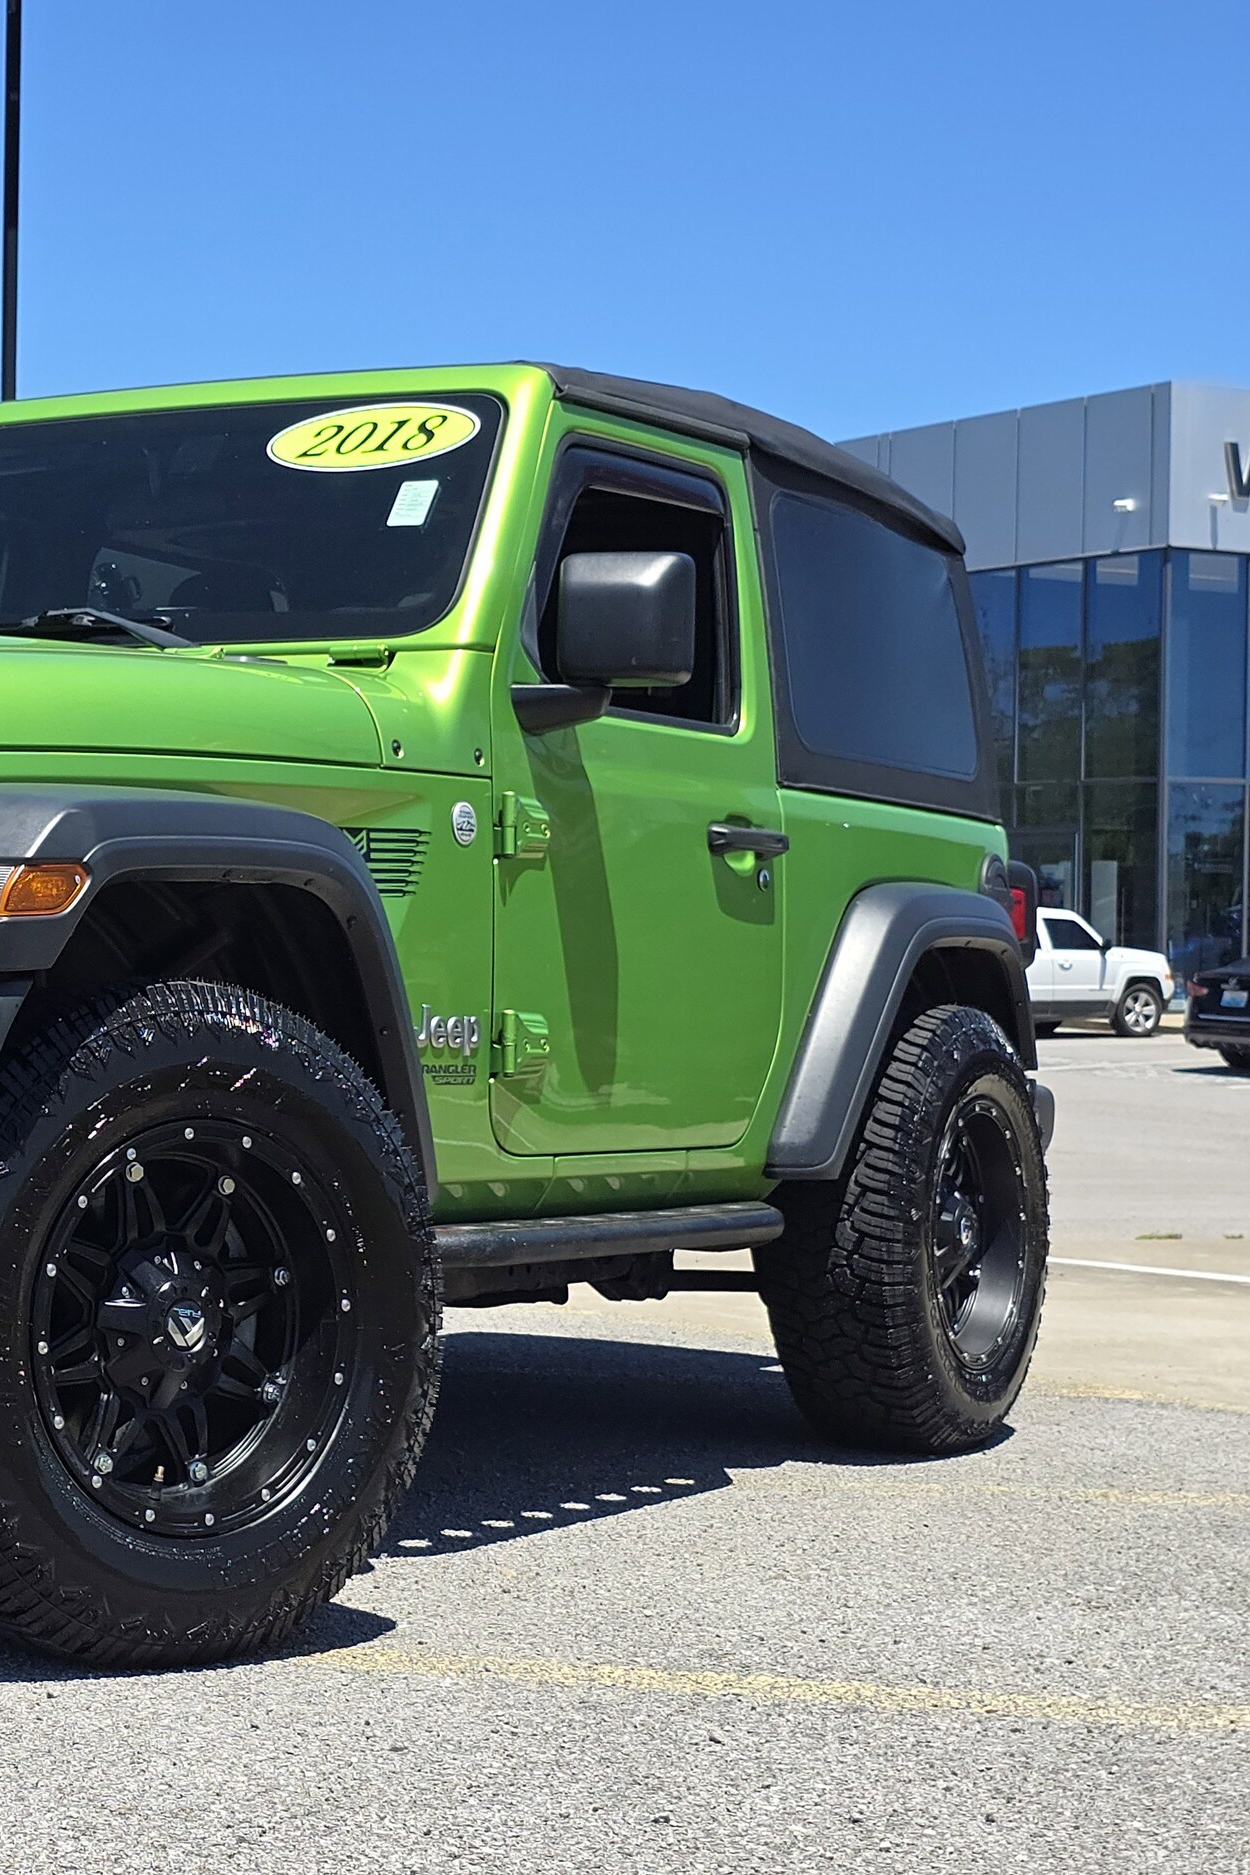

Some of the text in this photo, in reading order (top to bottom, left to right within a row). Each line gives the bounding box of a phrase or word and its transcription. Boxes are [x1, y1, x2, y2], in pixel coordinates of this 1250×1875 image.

[294, 414, 448, 459] 2018
[414, 1003, 479, 1056] Jeep
[421, 1064, 477, 1075] RANGLER
